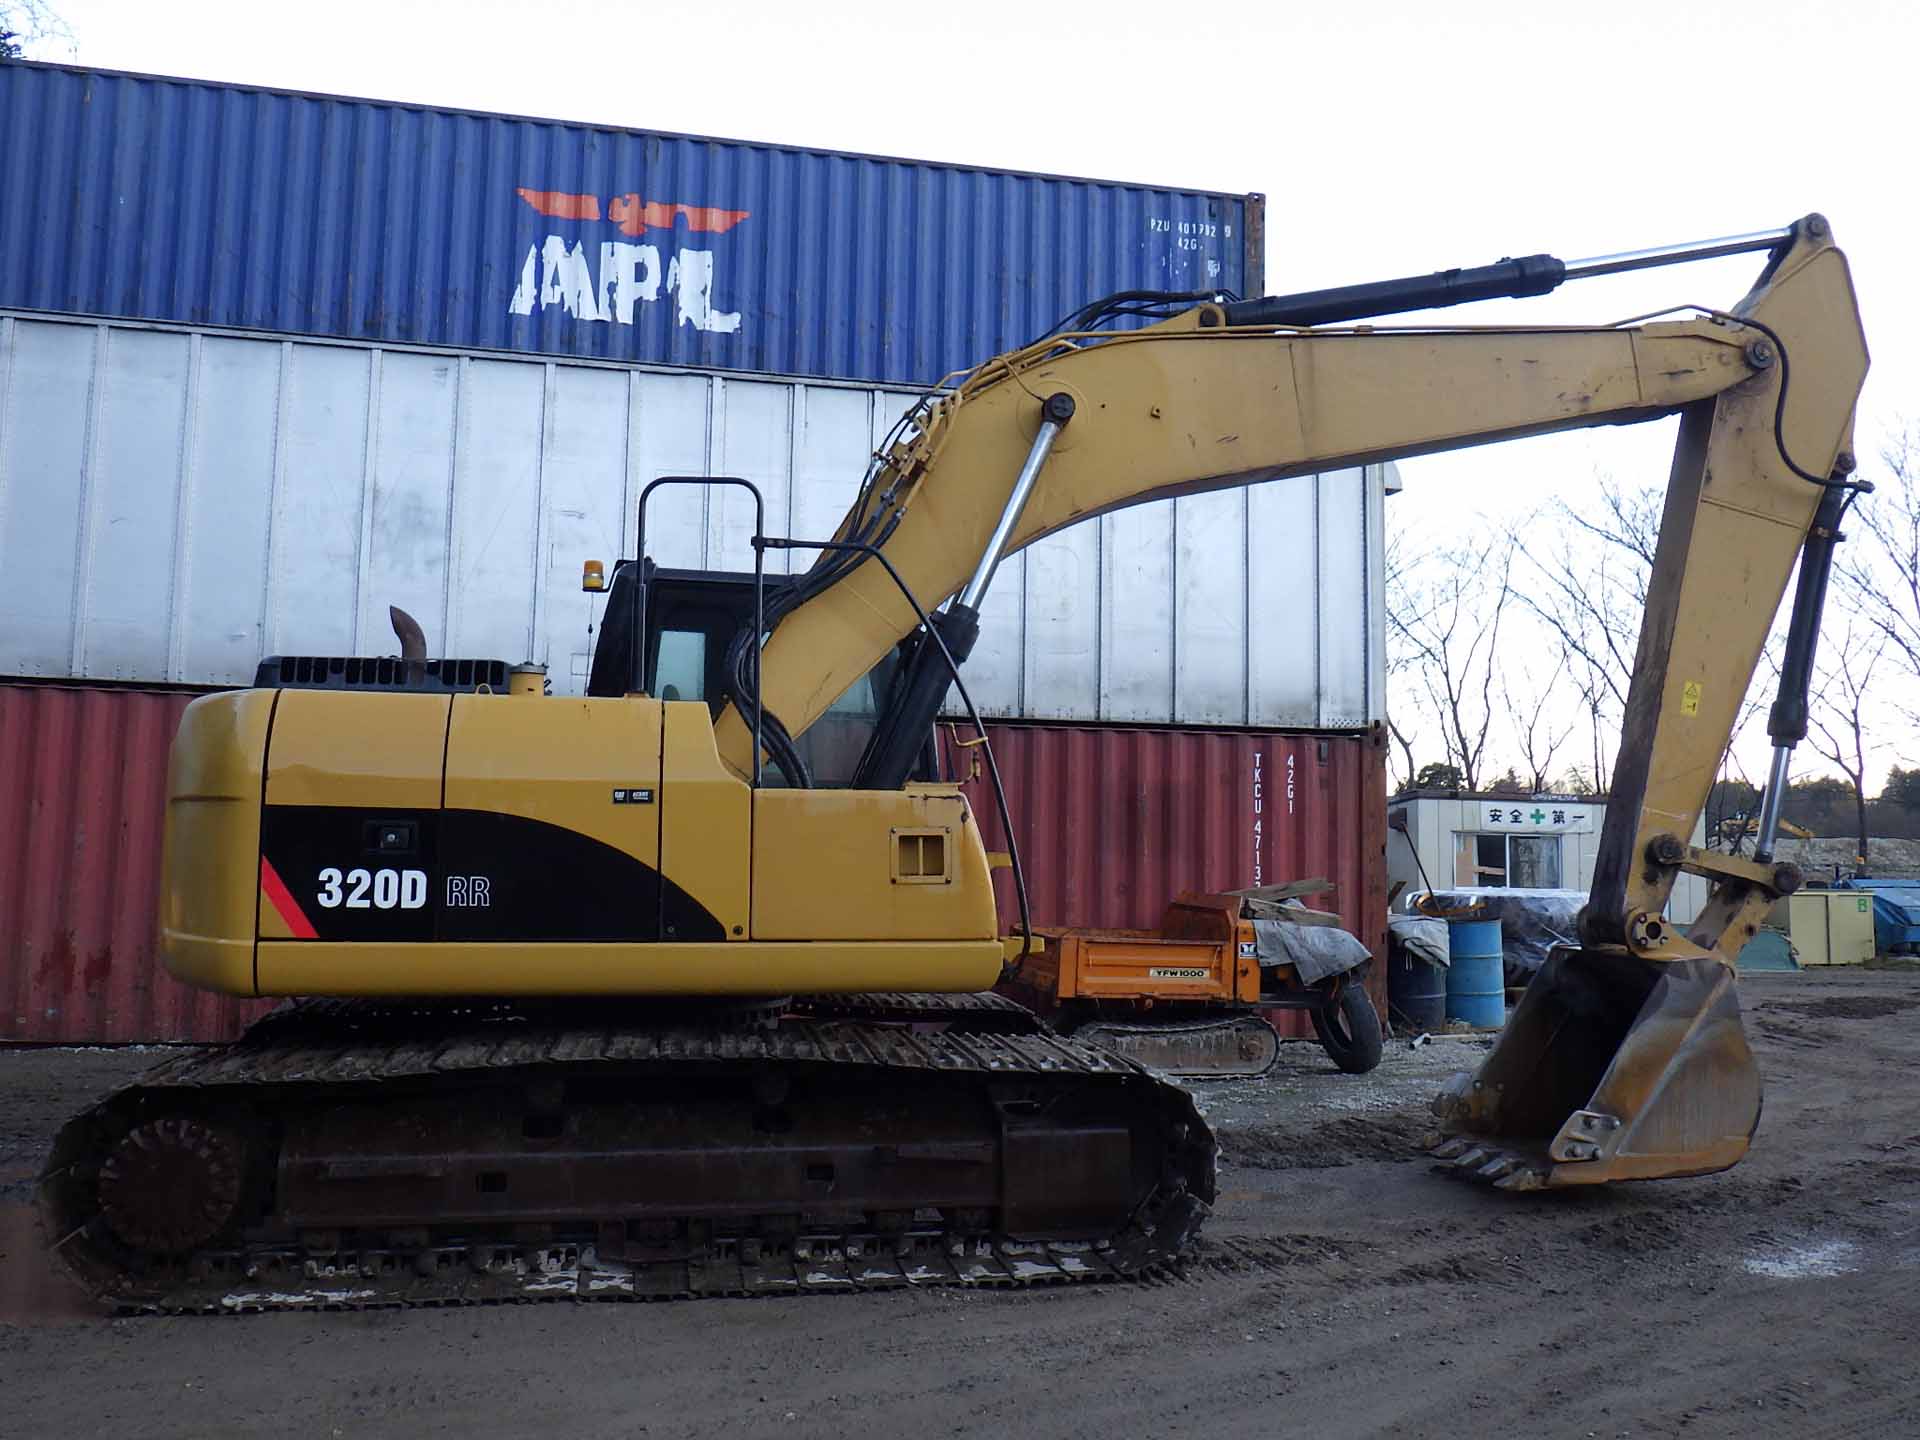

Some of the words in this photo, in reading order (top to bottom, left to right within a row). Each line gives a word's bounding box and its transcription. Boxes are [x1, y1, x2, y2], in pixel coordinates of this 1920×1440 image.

[508, 234, 741, 333] APL
[1254, 753, 1262, 814] TKCU
[317, 867, 428, 910] 320D
[446, 876, 490, 908] RR
